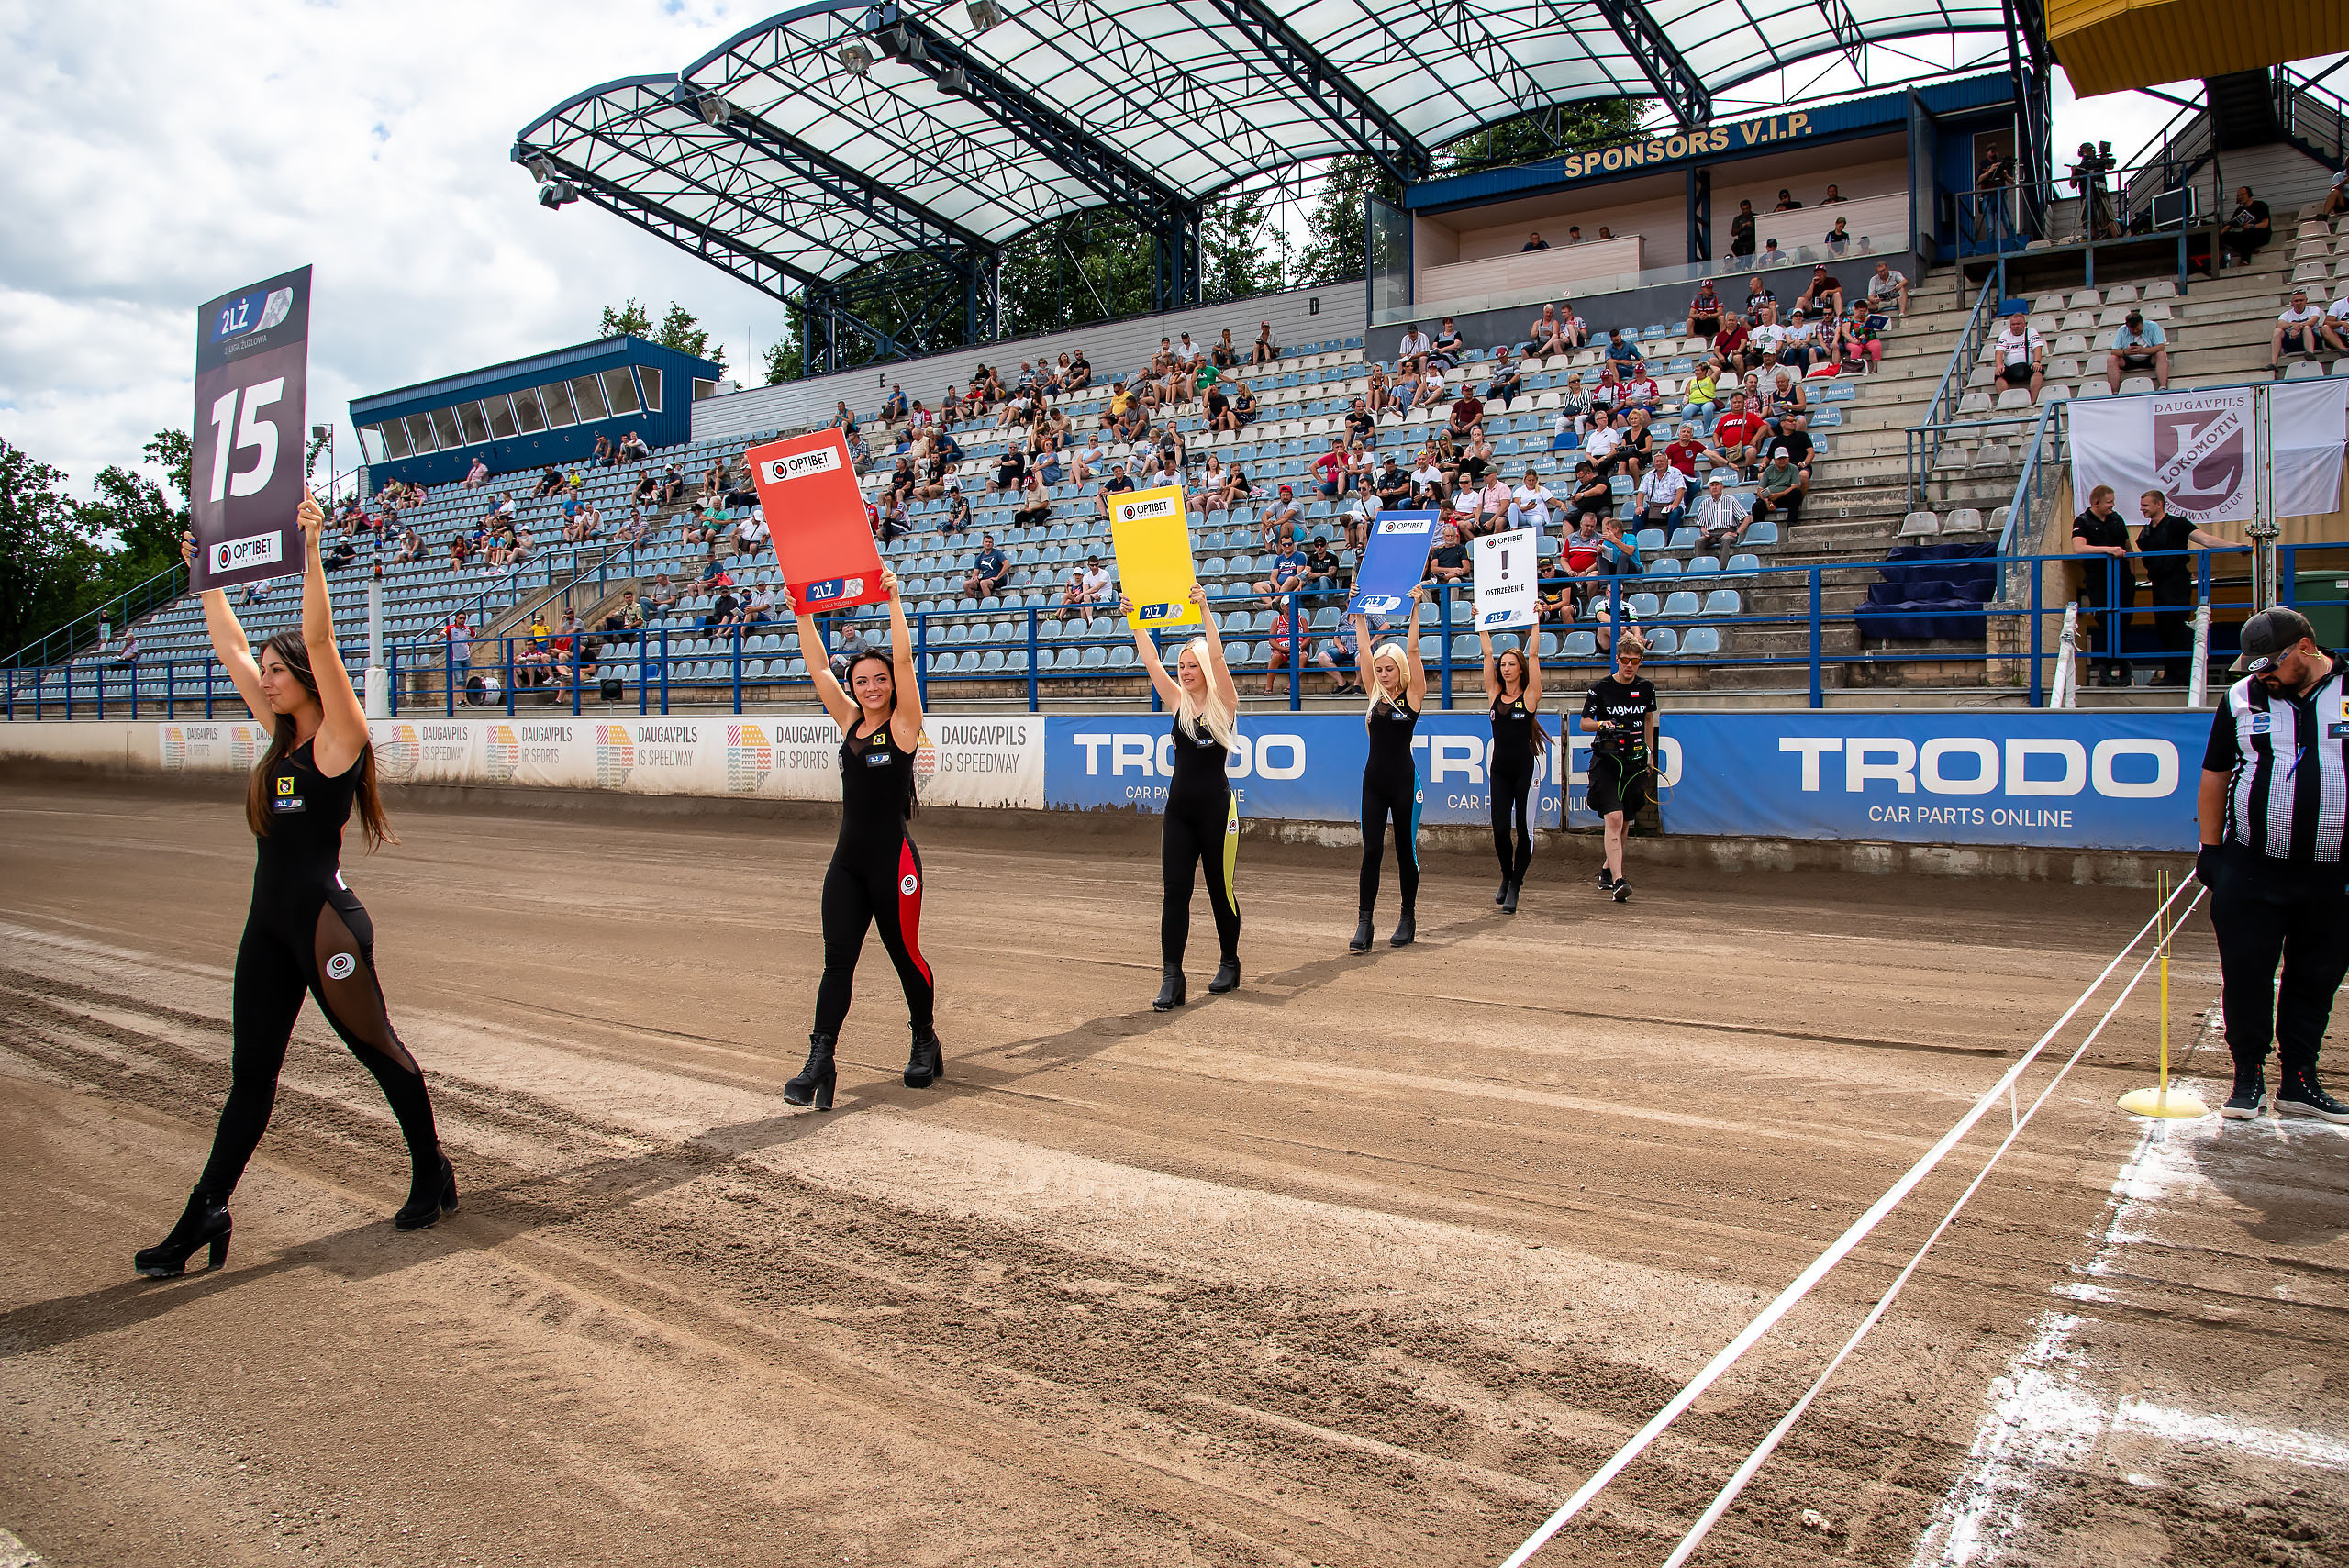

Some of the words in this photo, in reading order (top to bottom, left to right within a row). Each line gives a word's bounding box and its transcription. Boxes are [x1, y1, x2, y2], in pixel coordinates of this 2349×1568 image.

[1564, 127, 1730, 178] SPONSORS
[1740, 113, 1813, 145] V.I.P.
[1309, 296, 1319, 316] D
[221, 297, 250, 335] 2LŻ
[879, 373, 885, 388] E
[2154, 396, 2245, 413] DAUGAVPILS
[209, 376, 284, 503] 15
[2159, 412, 2240, 485] LOKOMOTIV
[789, 451, 829, 471] OPTIBET
[1137, 501, 1167, 515] OPTIBET
[2165, 500, 2210, 520] PEEDWAY
[2219, 492, 2244, 514] CLUB
[1397, 522, 1424, 530] OPTIBET
[1497, 534, 1524, 545] OPTIBET
[233, 538, 272, 559] OPTIBET
[1501, 550, 1508, 580] !
[813, 581, 835, 599] 2LŻ
[1486, 584, 1525, 596] OSTRZEŻENIE
[1364, 596, 1381, 606] 2LŻ
[1144, 604, 1162, 618] 2LŻ
[186, 727, 217, 740] DAUGAVPILS
[422, 726, 468, 741] DAUGAVPILS
[522, 726, 573, 742] DAUGAVPILS
[638, 726, 698, 743] DAUGAVPILS
[776, 726, 843, 745] DAUGAVPIL
[941, 725, 1027, 746] DAUGAVPILS
[422, 746, 429, 761] IS
[430, 746, 465, 762] SPEEDWAY
[522, 748, 531, 763] IR
[533, 748, 560, 764] SPORTS
[638, 750, 646, 766] IS
[649, 750, 694, 767] SPEEDWAY
[776, 751, 786, 769] IR
[789, 751, 829, 770] SPORTS
[941, 752, 952, 772] IS
[956, 752, 1020, 773] SPEEDWAY
[1778, 737, 2179, 798] TRODO
[1125, 785, 1152, 799] CAR
[1447, 794, 1480, 809] CAR
[1868, 805, 1910, 823] CAR
[1917, 806, 1985, 825] PARTS
[1991, 808, 2073, 828] ONLINE
